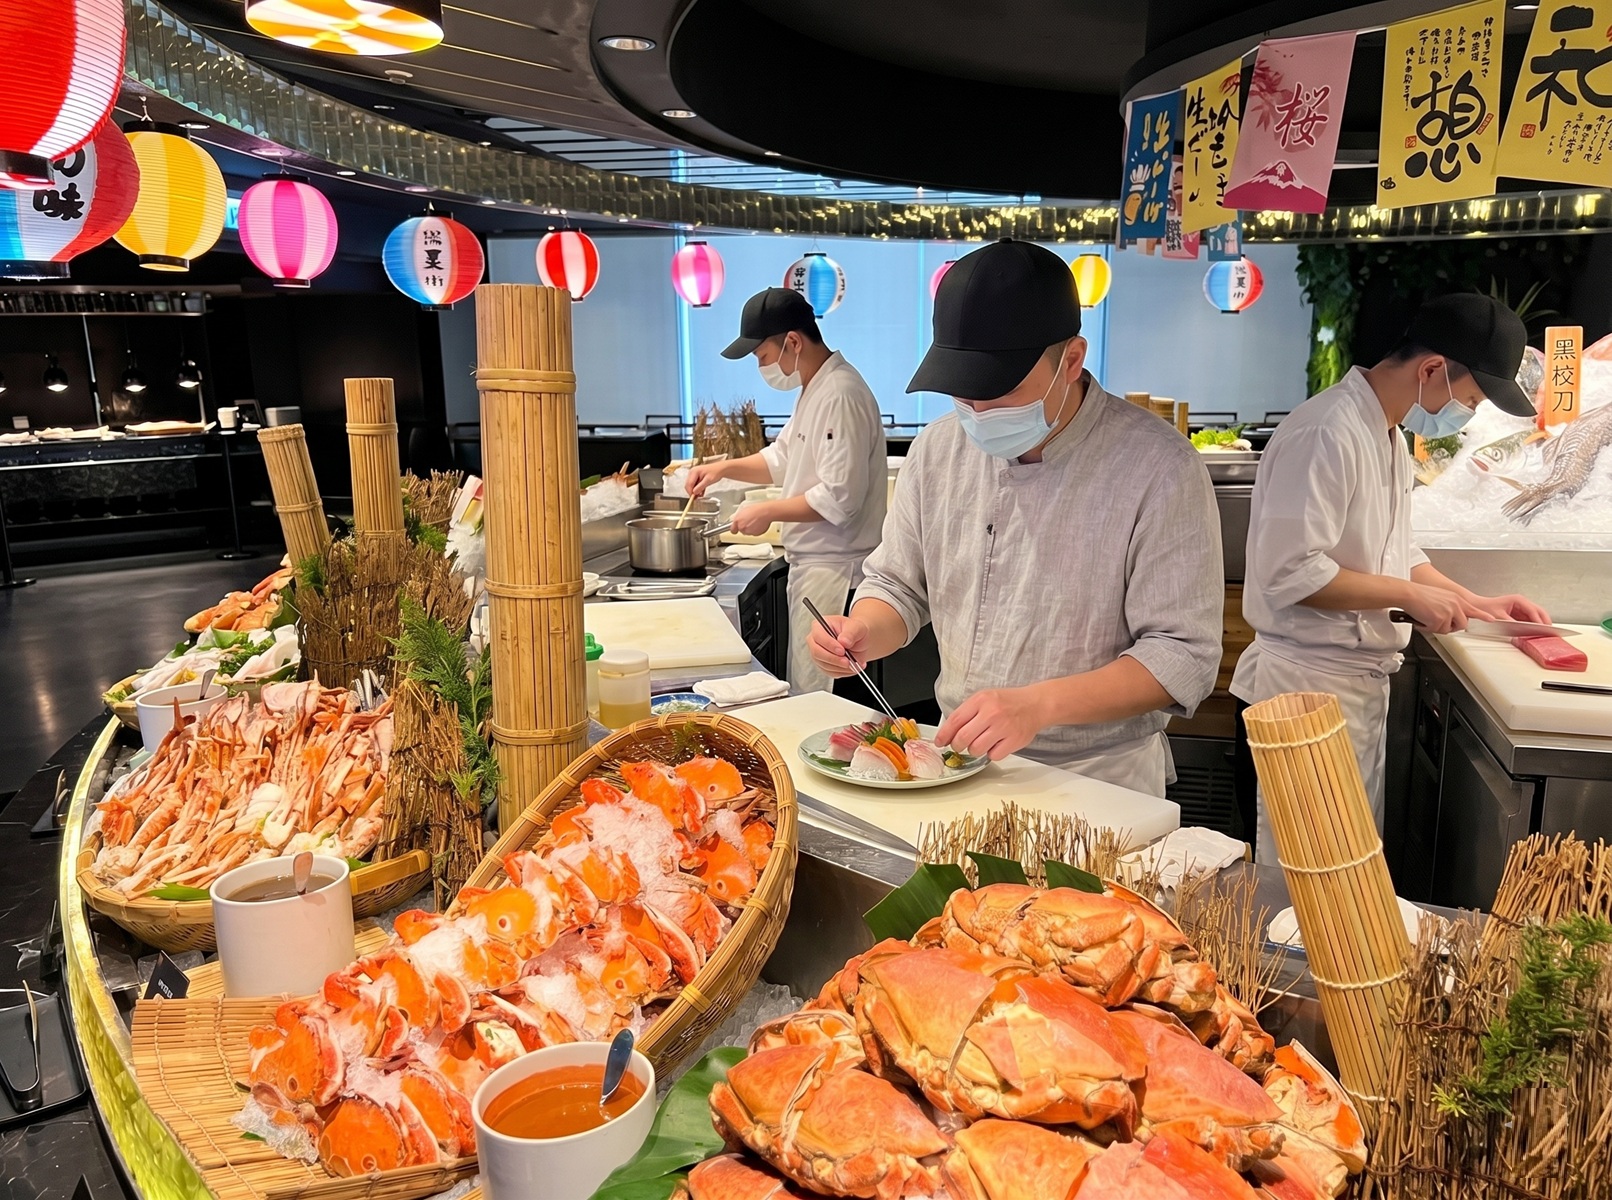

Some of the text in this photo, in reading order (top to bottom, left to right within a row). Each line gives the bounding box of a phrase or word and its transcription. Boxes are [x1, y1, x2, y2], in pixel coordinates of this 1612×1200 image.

[1274, 82, 1330, 149] 桜
[1552, 339, 1576, 412] 黑校刀
